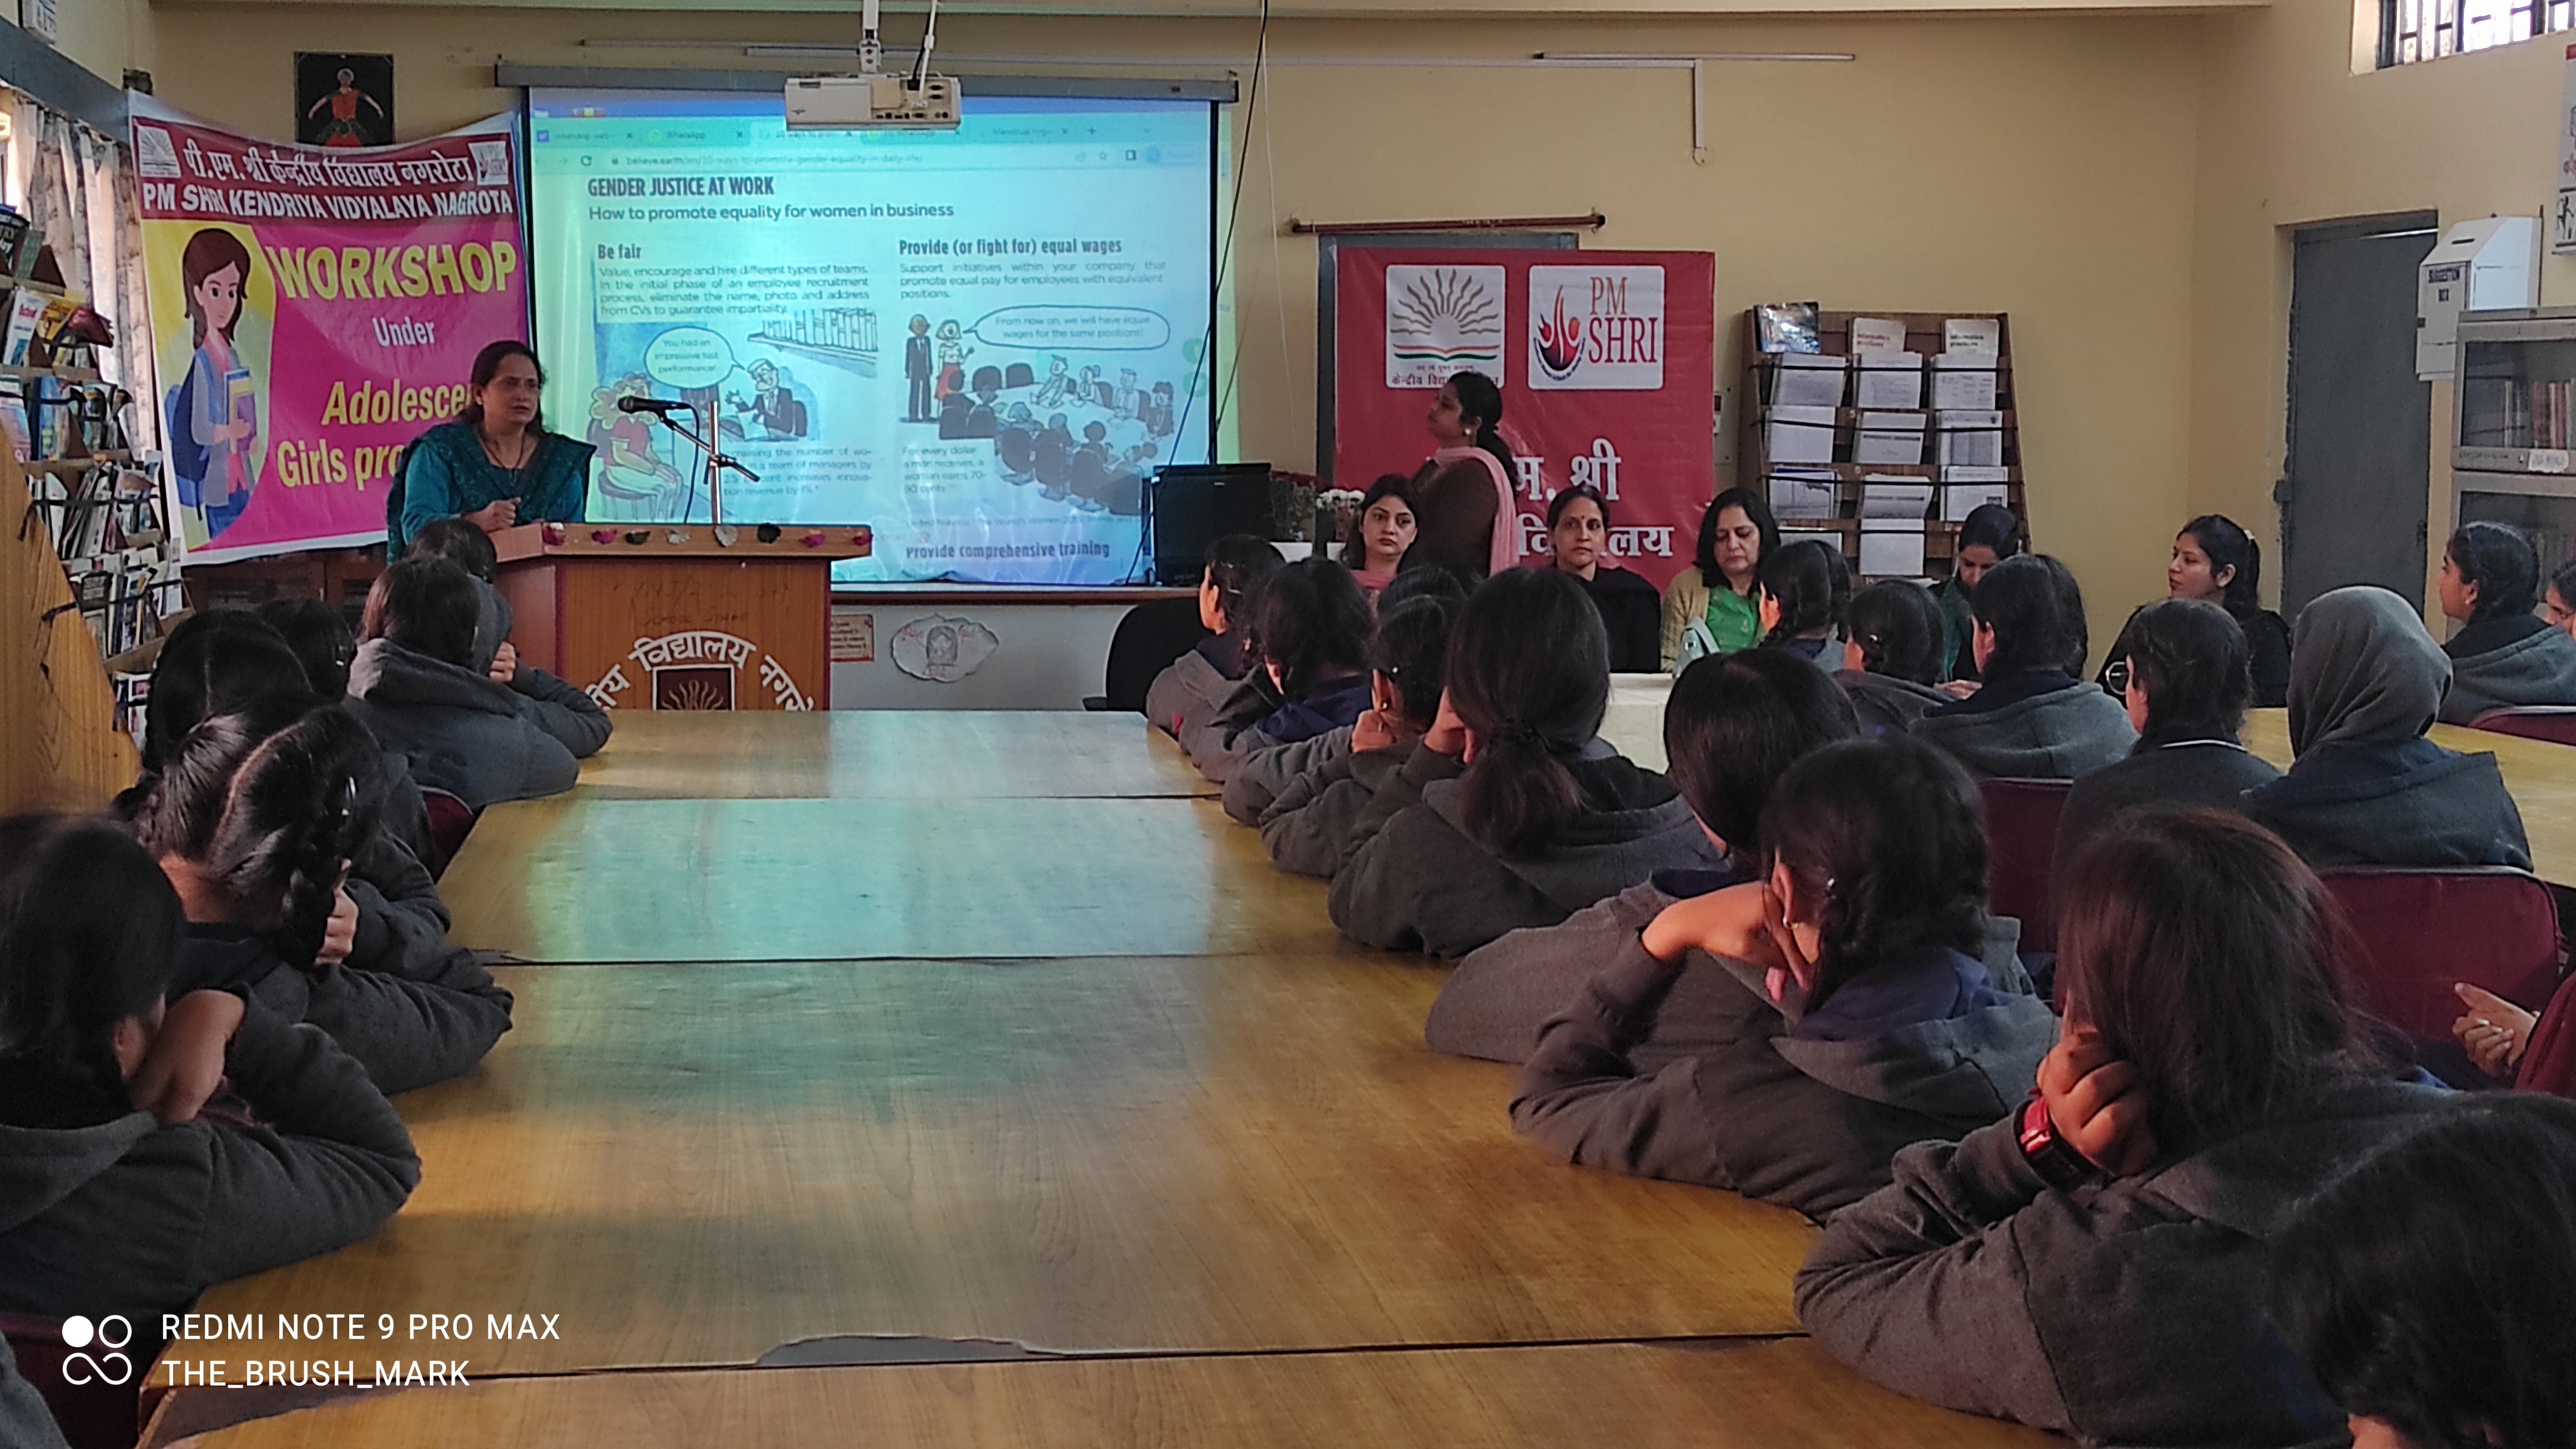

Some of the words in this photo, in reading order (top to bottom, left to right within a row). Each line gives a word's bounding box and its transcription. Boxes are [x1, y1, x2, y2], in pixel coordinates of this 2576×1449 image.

[242, 146, 272, 183] श्री
[322, 156, 401, 187] विद्यालय
[396, 149, 474, 186] नगरोटा
[587, 178, 646, 197] GENDER
[650, 177, 704, 197] JUSTICE
[708, 177, 726, 196] AT
[728, 176, 774, 196] WORK
[142, 182, 175, 212] PM
[181, 184, 230, 215] SHRI
[229, 189, 329, 219] KENDRIYA
[324, 194, 433, 220] VIDYALAYA
[431, 189, 513, 217] NAGROTA
[589, 207, 625, 220] How
[629, 207, 645, 220] to
[648, 206, 717, 222] promote
[720, 204, 782, 222] equality
[785, 204, 807, 218] for
[809, 206, 867, 218] women
[870, 203, 883, 217] in
[887, 203, 954, 217] business
[598, 244, 615, 259] Be
[618, 243, 641, 259] fair
[899, 239, 949, 255] Provide
[953, 239, 973, 256] (or
[977, 238, 1008, 256] fight
[1012, 238, 1037, 255] for)
[1042, 238, 1077, 256] equal
[1081, 240, 1122, 255] wages
[264, 240, 517, 300] WORKSHOP
[599, 267, 632, 278] Value,
[634, 268, 692, 278] encourage
[694, 266, 715, 275] and
[717, 266, 737, 275] hire
[740, 265, 784, 275] different
[787, 265, 817, 276] types
[820, 264, 831, 274] of
[900, 263, 943, 273] Support
[953, 263, 1002, 272] initiatives
[1011, 263, 1044, 271] within
[1052, 263, 1076, 273] your
[1085, 262, 1135, 271] company
[1145, 261, 1165, 270] that
[600, 280, 610, 290] In
[616, 280, 633, 290] the
[640, 279, 667, 289] initial
[673, 279, 706, 290] phase
[712, 278, 722, 288] of
[728, 280, 742, 288] an
[747, 279, 801, 289] employee
[807, 278, 868, 287] recruitment
[900, 276, 947, 286] promote
[949, 275, 978, 286] equal
[982, 276, 1000, 286] pay
[1004, 275, 1019, 284] for
[1022, 275, 1080, 285] employees
[1083, 274, 1105, 283] with
[1108, 274, 1163, 284] equivalent
[601, 293, 645, 303] process,
[650, 292, 699, 302] eliminate
[704, 292, 722, 301] the
[727, 293, 760, 301] name,
[764, 291, 797, 301] photo
[802, 290, 823, 300] and
[827, 290, 869, 300] address
[901, 289, 950, 299] positions.
[1589, 276, 1628, 315] PM
[601, 305, 627, 315] from
[630, 305, 651, 315] CVs
[654, 305, 666, 315] to
[669, 305, 723, 316] guarantee
[996, 316, 1021, 325] From
[1080, 316, 1096, 324] will
[1098, 316, 1120, 325] have
[371, 316, 435, 347] Under
[1003, 330, 1034, 339] wages
[1035, 329, 1049, 338] for
[1051, 329, 1067, 338] the
[1588, 316, 1658, 364] SHRI
[321, 378, 472, 426] Adolesce
[776, 447, 792, 456] the
[276, 439, 348, 489] Girls
[353, 442, 405, 491] pro
[1513, 456, 1557, 501] म.
[1569, 438, 1622, 501] श्री
[906, 544, 955, 558] Provide
[959, 542, 1055, 559] comprehensive
[1059, 540, 1110, 557] training
[627, 630, 757, 672] विद्यालय
